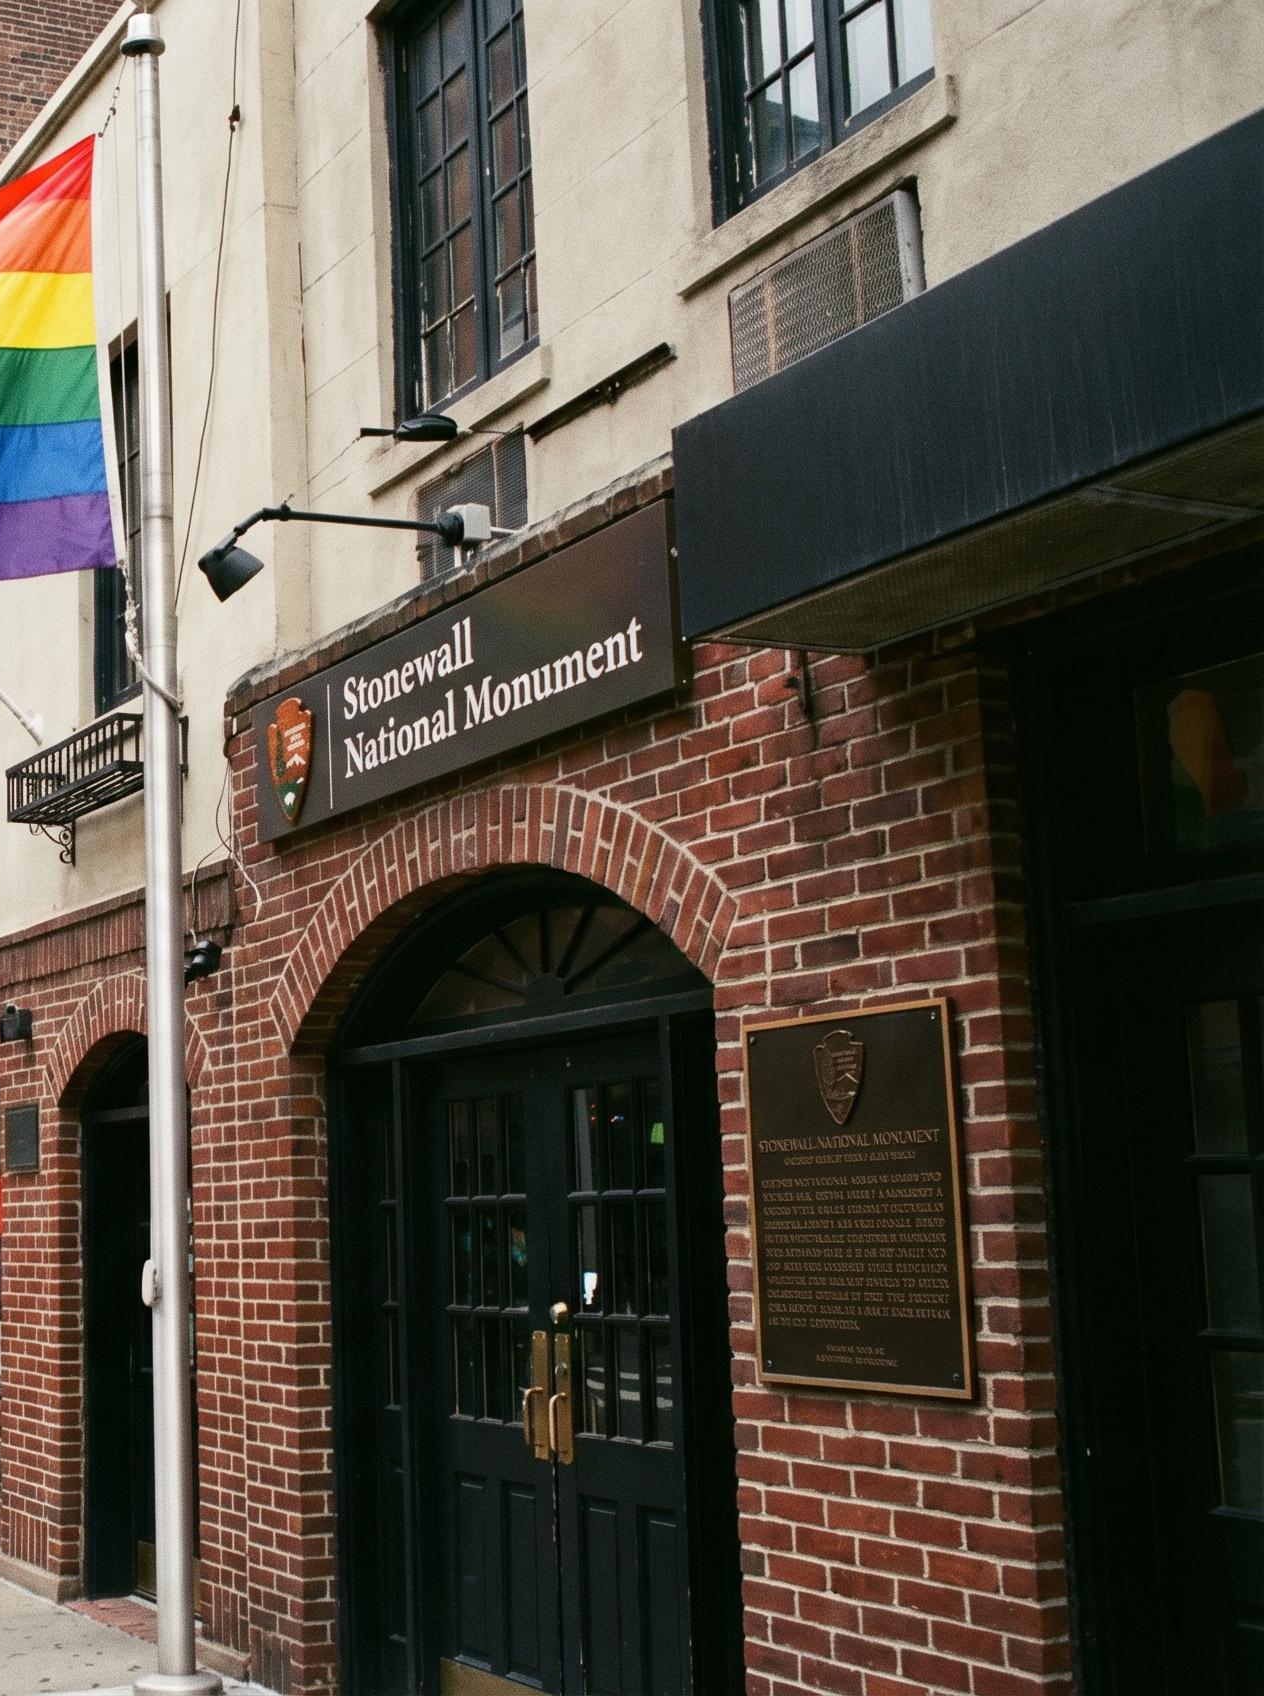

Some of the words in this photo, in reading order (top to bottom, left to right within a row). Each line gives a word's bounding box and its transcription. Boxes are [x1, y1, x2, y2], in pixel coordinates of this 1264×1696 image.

[343, 616, 474, 720] Stonewall
[344, 689, 457, 779] National
[463, 616, 643, 731] Monument
[872, 1128, 941, 1146] MONUMENT
